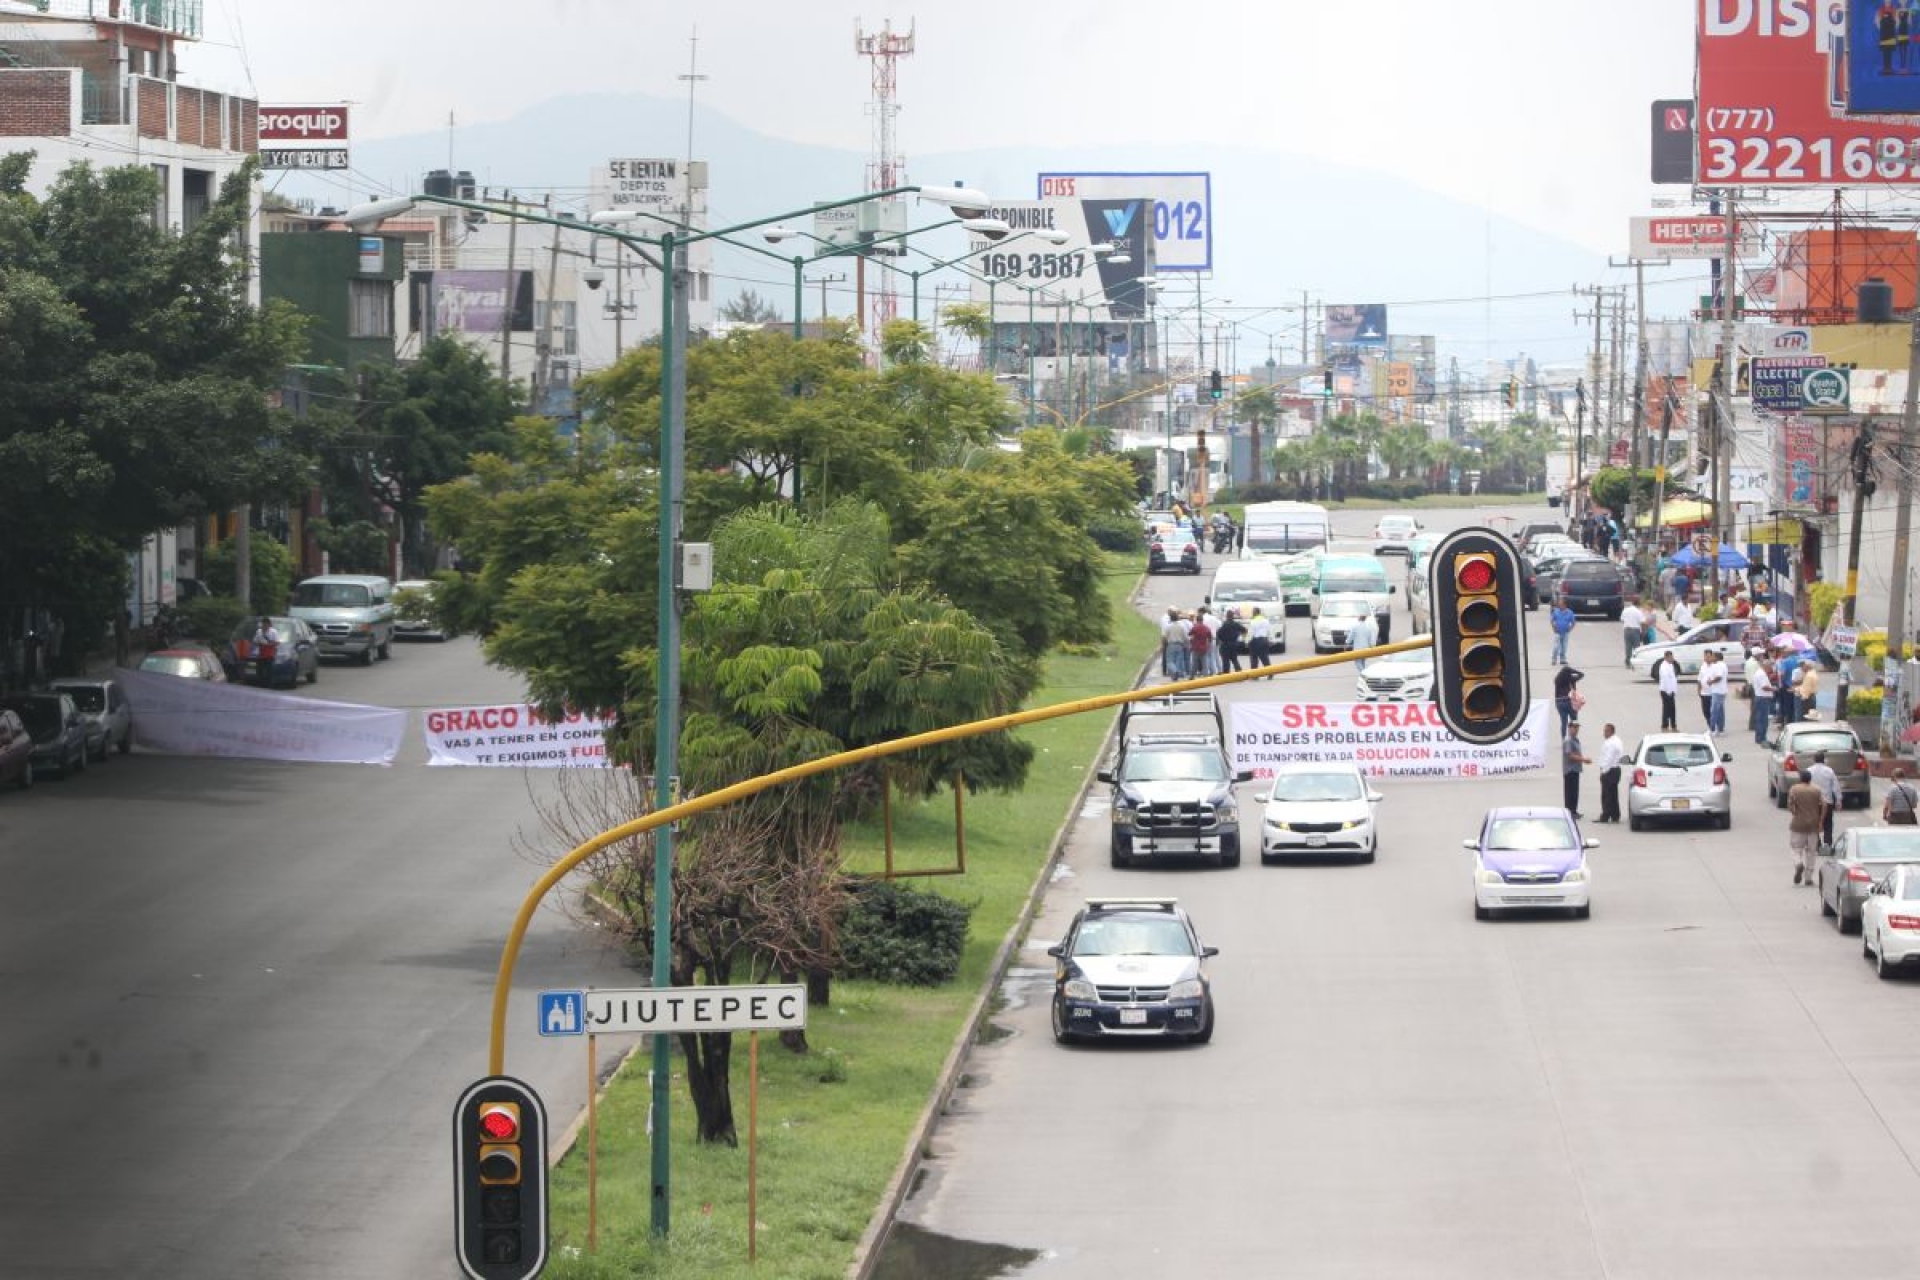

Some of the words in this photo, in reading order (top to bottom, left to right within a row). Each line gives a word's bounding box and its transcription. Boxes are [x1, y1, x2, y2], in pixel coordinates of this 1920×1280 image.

[259, 110, 341, 135] eroquip
[1706, 107, 1775, 131] (777)
[610, 161, 626, 178] SE
[630, 161, 676, 179] RENTAN
[620, 180, 667, 191] DEPTOS
[982, 207, 1055, 229] ISPONIBLE
[980, 253, 1022, 279] 169
[1028, 252, 1084, 279] 3587
[1756, 369, 1803, 380] ELECTRI
[428, 706, 519, 734] GRACO
[1282, 703, 1339, 729] SR.
[1351, 703, 1446, 727] GRAC
[443, 738, 471, 749] VAS
[475, 736, 485, 746] A
[488, 733, 535, 745] TENER
[540, 732, 558, 741] EN
[563, 729, 604, 740] CONF
[1236, 732, 1258, 745] NO
[1262, 732, 1310, 745] DEJES
[1314, 730, 1406, 744] PROBLEMAS
[1411, 730, 1431, 743] EN
[1436, 730, 1458, 743] LO
[477, 754, 494, 764] TE
[498, 749, 567, 763] EXIGIMOS
[571, 744, 605, 757] FUE
[1237, 752, 1250, 763] DE
[1254, 751, 1321, 763] TRANSPORTE
[1324, 751, 1337, 761] YA
[1340, 751, 1353, 761] DA
[1356, 747, 1430, 761] SOLUCION
[1433, 751, 1441, 759] A
[1444, 750, 1470, 759] ESTE
[1471, 749, 1529, 759] CONFLICTO
[1253, 767, 1275, 780] ERA
[1456, 763, 1478, 777] 148
[594, 994, 797, 1025] JIUTEPEC
